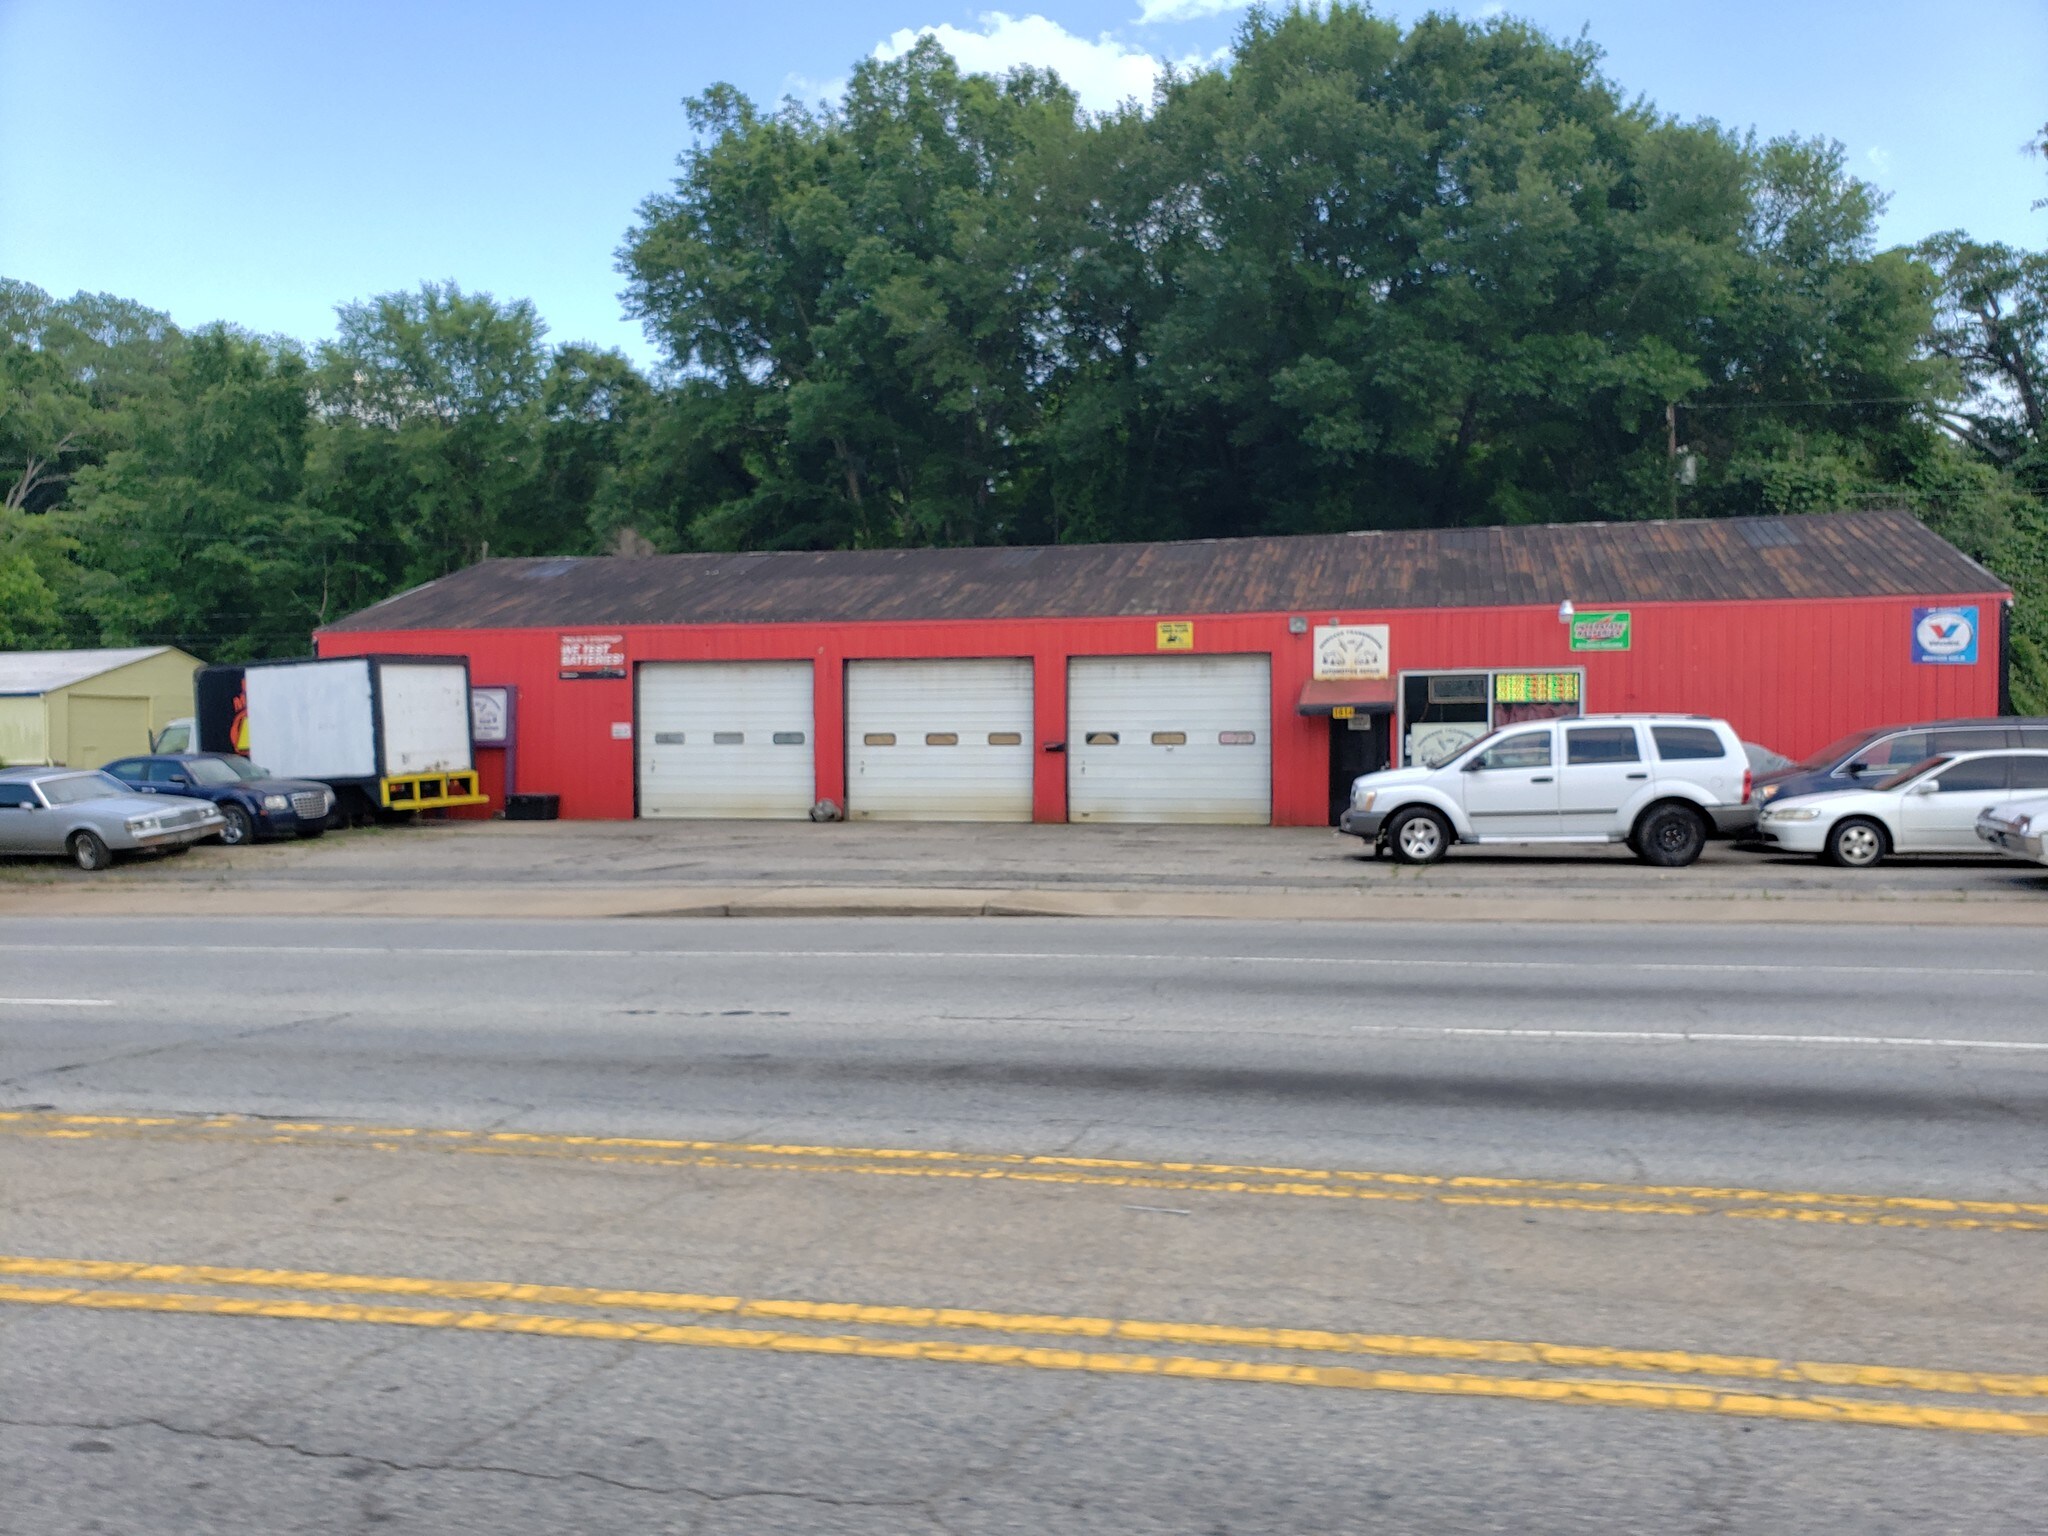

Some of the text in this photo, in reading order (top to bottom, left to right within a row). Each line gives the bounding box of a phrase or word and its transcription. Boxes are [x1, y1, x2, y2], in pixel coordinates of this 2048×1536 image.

[561, 643, 611, 655] WE TEST
[561, 653, 625, 666] BATTERIES!
